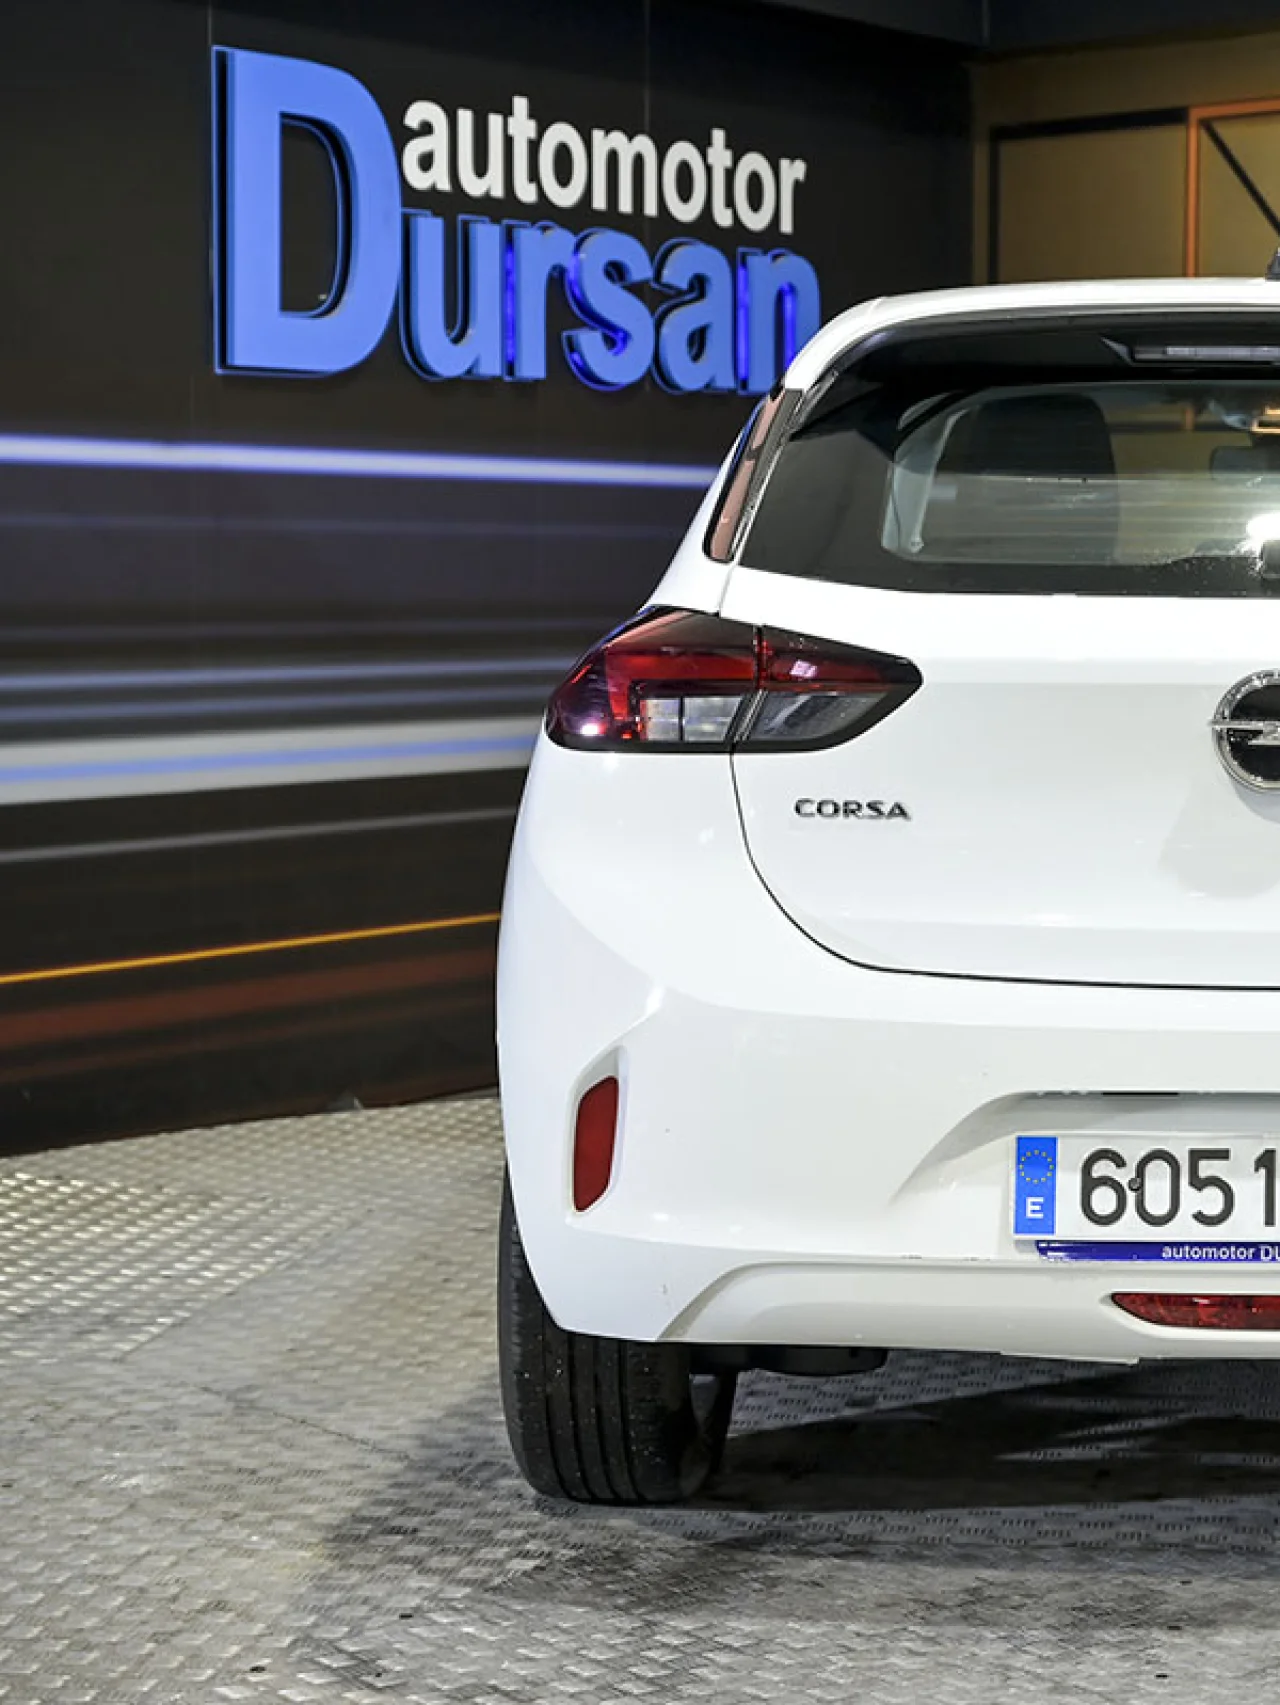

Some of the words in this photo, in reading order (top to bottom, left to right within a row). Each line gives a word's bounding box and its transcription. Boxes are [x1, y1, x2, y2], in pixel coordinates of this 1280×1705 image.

[402, 95, 807, 234] automotor
[212, 44, 820, 398] Dursan
[795, 797, 912, 821] CORSA
[1024, 1197, 1045, 1219] E
[1080, 1147, 1277, 1228] 6051
[1160, 1244, 1255, 1261] automotor
